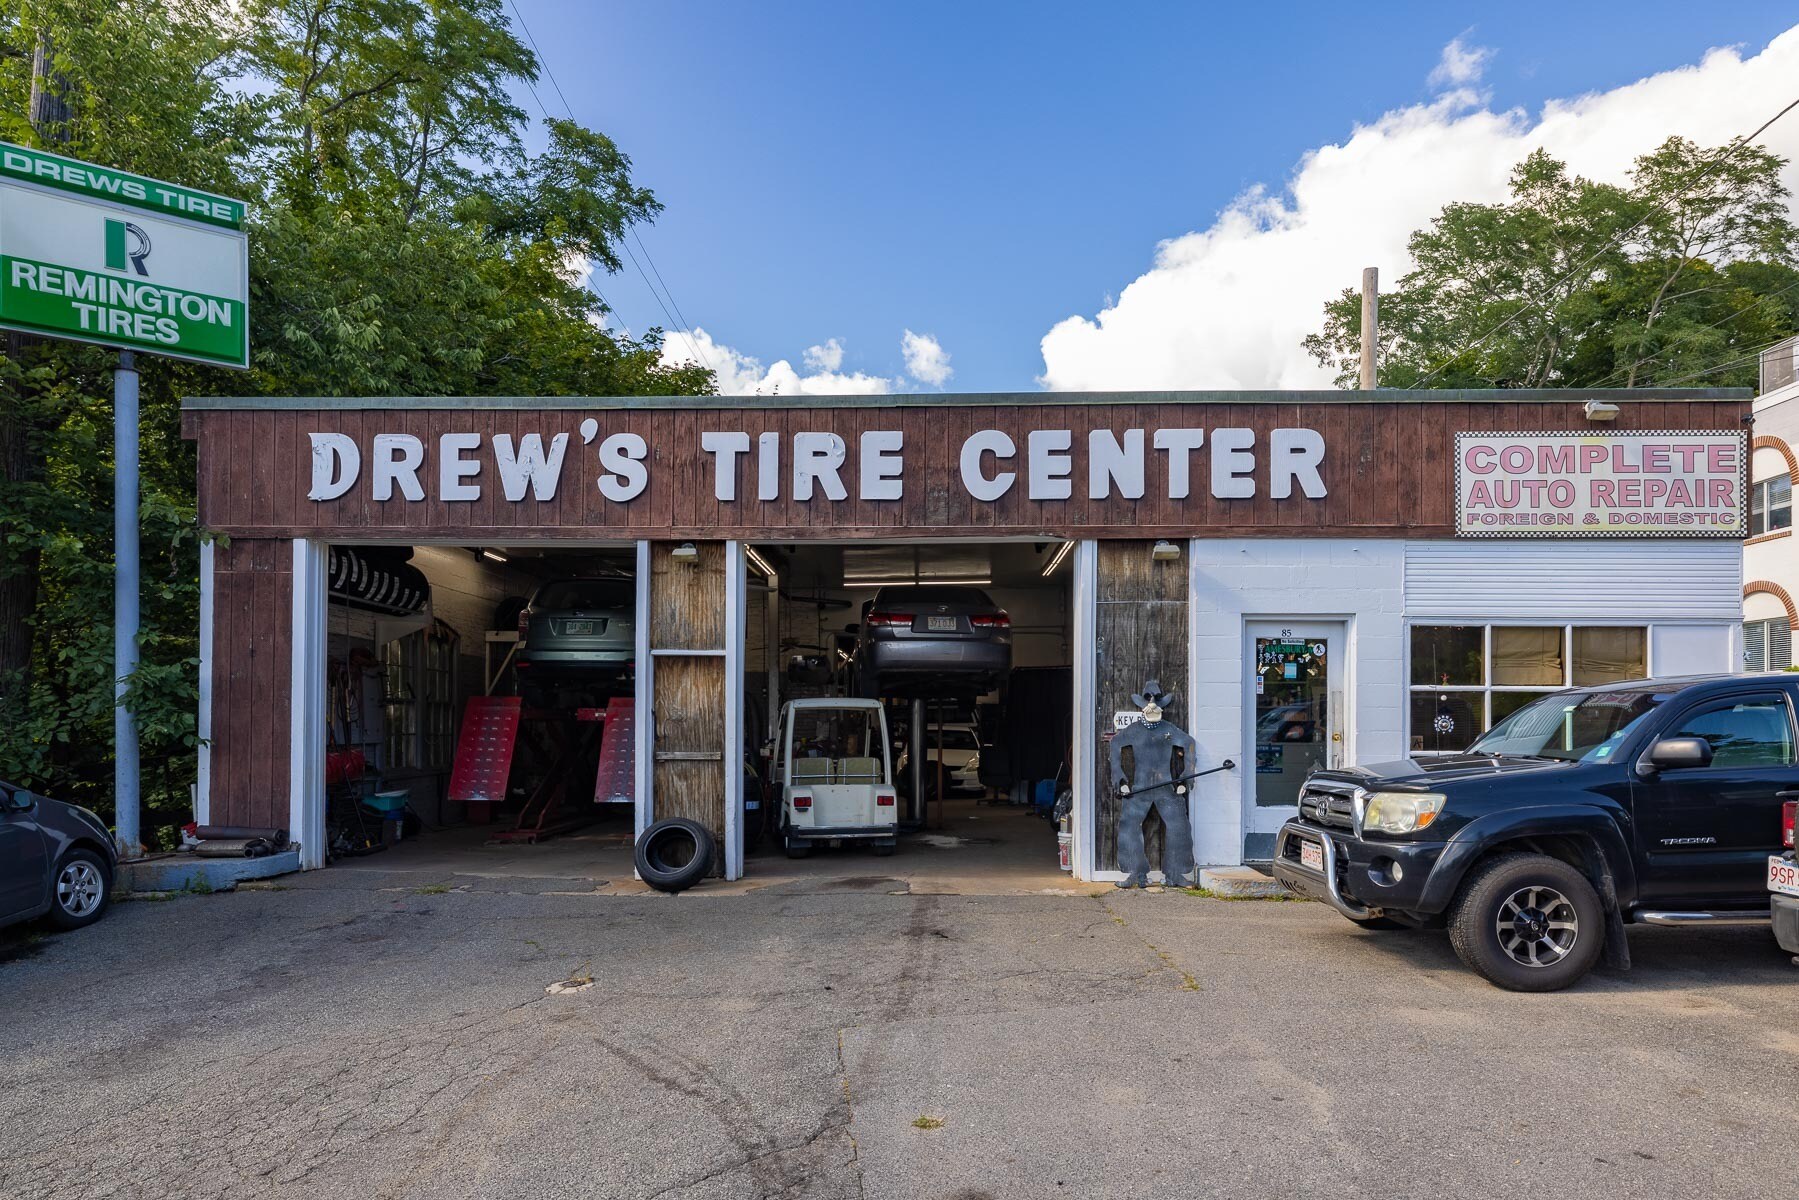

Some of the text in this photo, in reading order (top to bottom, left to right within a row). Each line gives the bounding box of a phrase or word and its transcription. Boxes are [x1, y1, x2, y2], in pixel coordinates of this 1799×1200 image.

[4, 151, 232, 221] DREWS TIRE
[11, 260, 232, 327] REMINGTON
[71, 301, 180, 344] TIRES
[307, 418, 1328, 502] DREW'S TIRE CENTER
[1465, 444, 1737, 474] COMPLETE
[1466, 478, 1736, 509] AUTO REPAIR
[1467, 512, 1736, 525] FOREIGN & DOMESTIC
[1281, 629, 1292, 637] 85
[1118, 715, 1134, 726] KEY
[1660, 837, 1716, 845] TACOMA
[1770, 866, 1795, 886] 9SR
